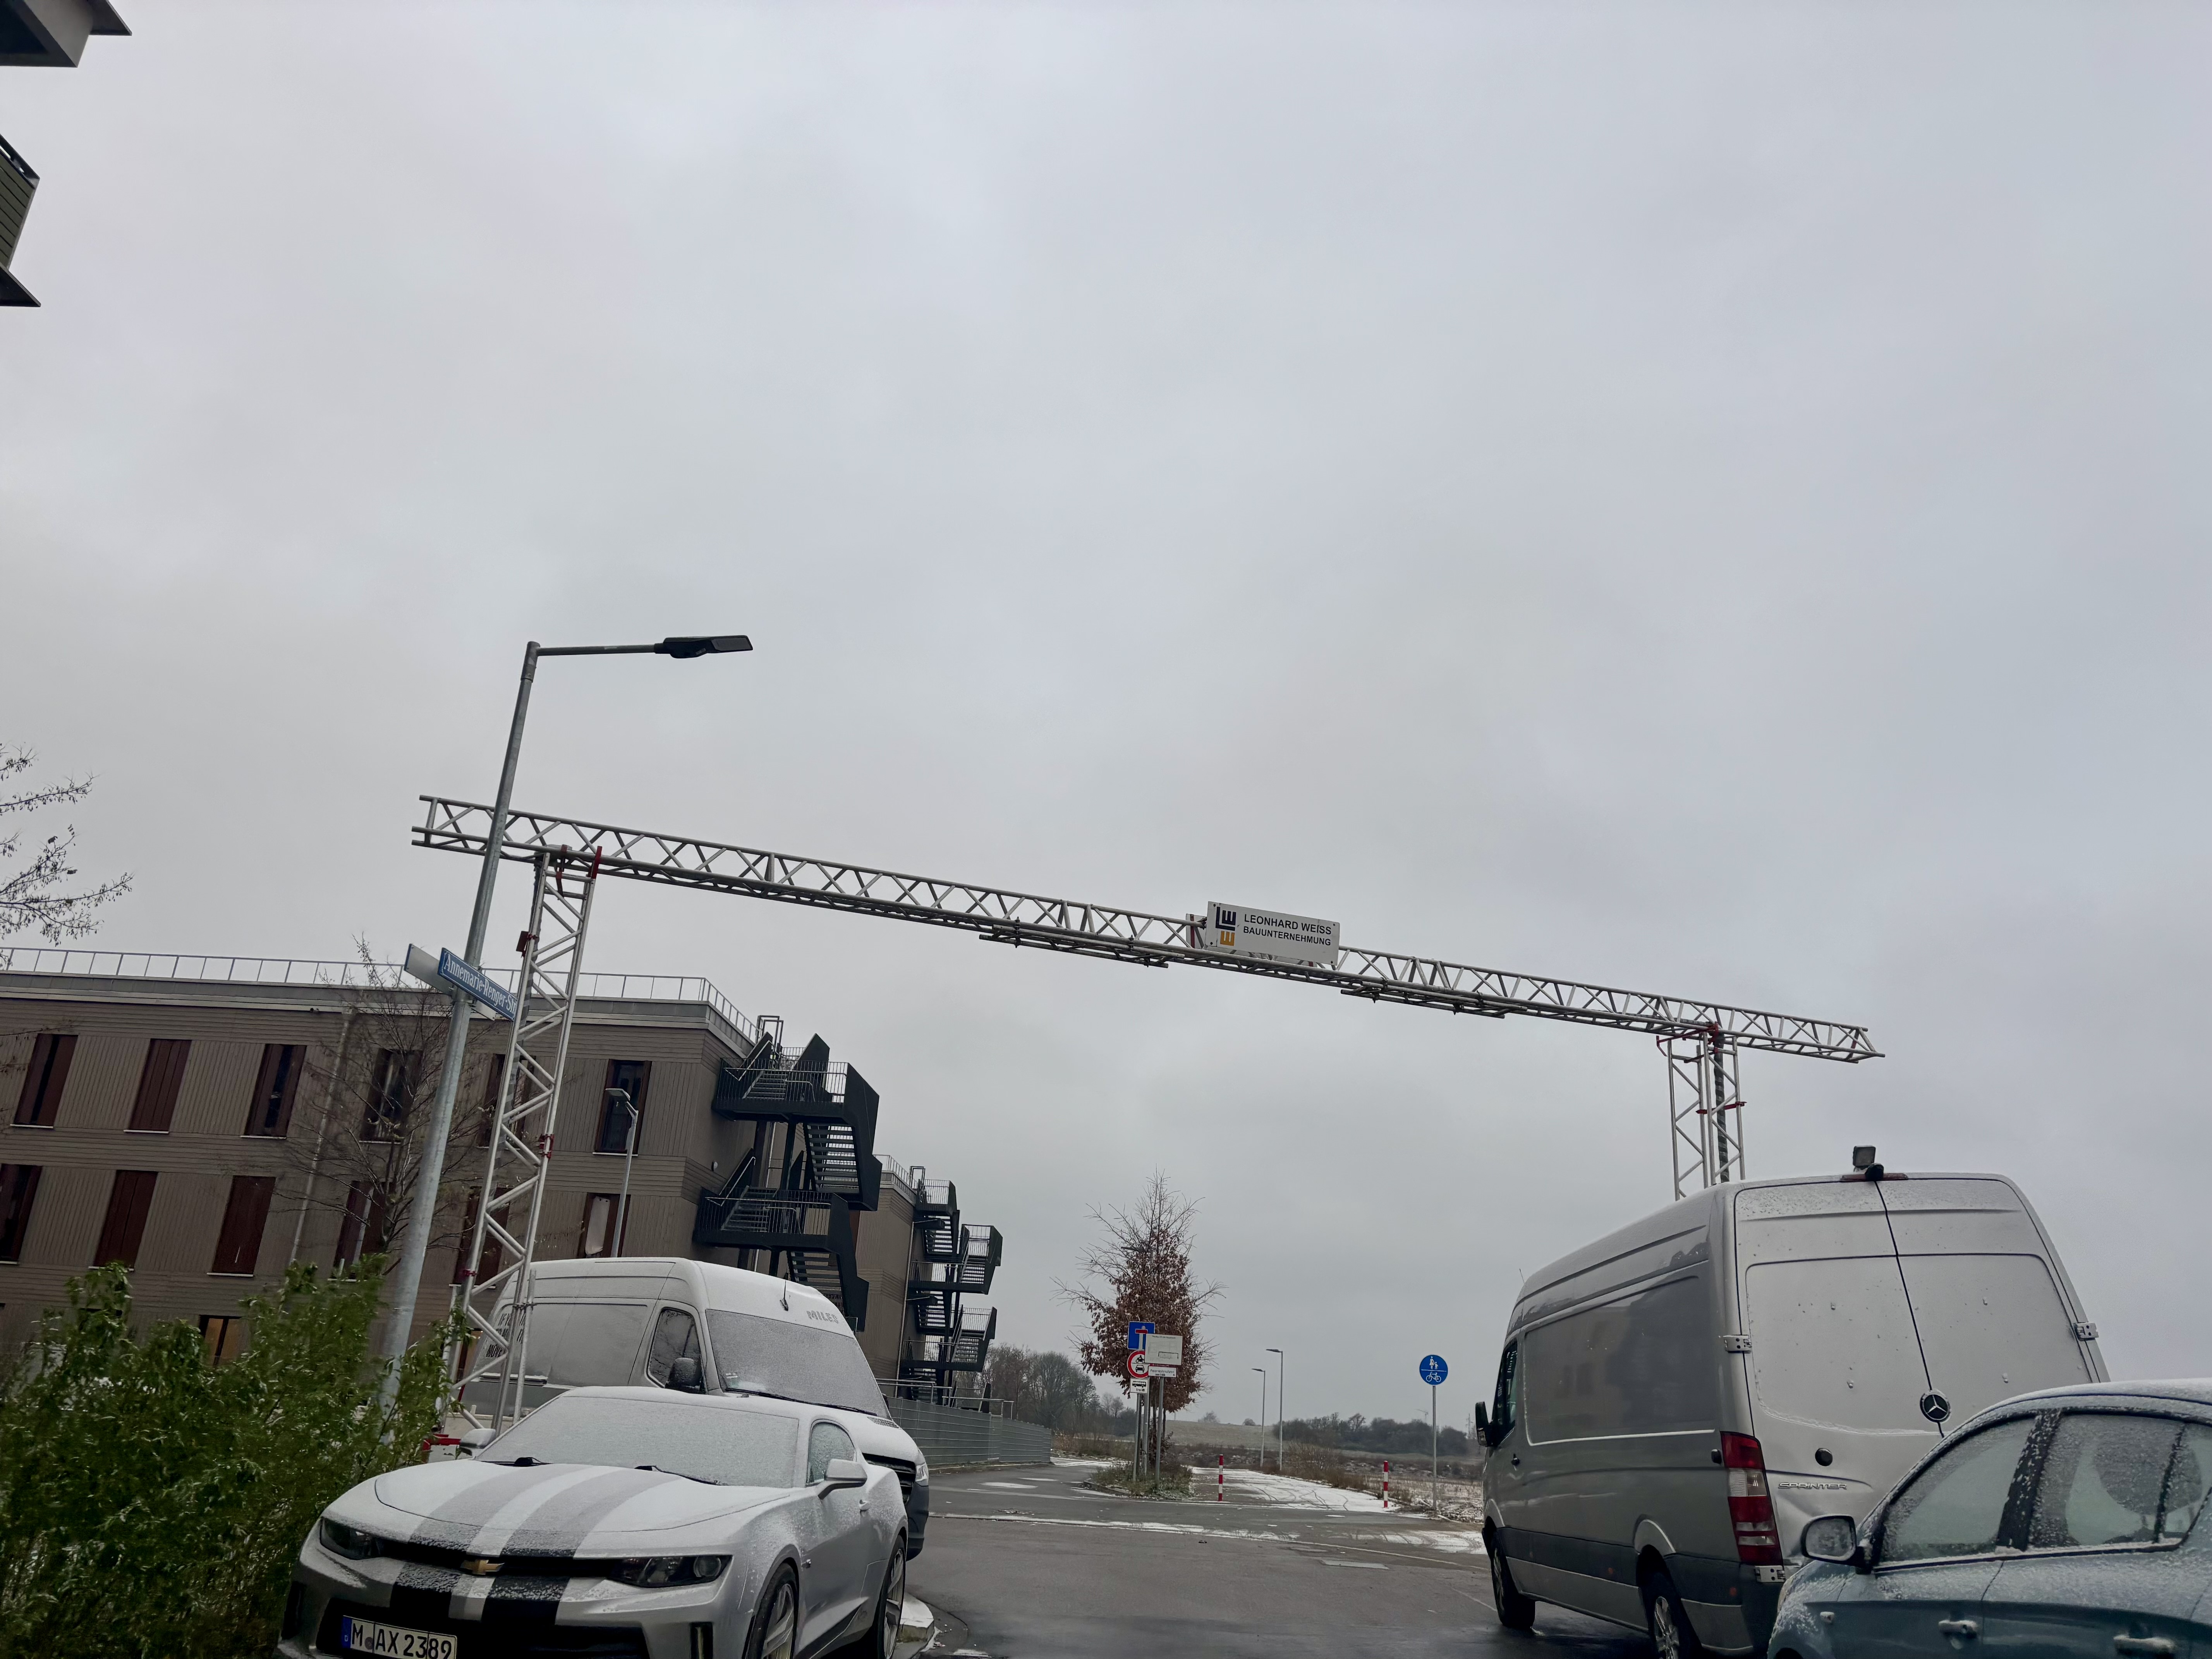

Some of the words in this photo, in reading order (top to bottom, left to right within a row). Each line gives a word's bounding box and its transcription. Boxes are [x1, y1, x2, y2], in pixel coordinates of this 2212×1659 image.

[1244, 914, 1298, 930] LEONHARD
[1301, 922, 1331, 934] WEISS
[1243, 926, 1331, 946] BAUUNTERNEHMUNG
[806, 1310, 839, 1324] MILES
[352, 1623, 363, 1646] M
[375, 1629, 399, 1654] AX
